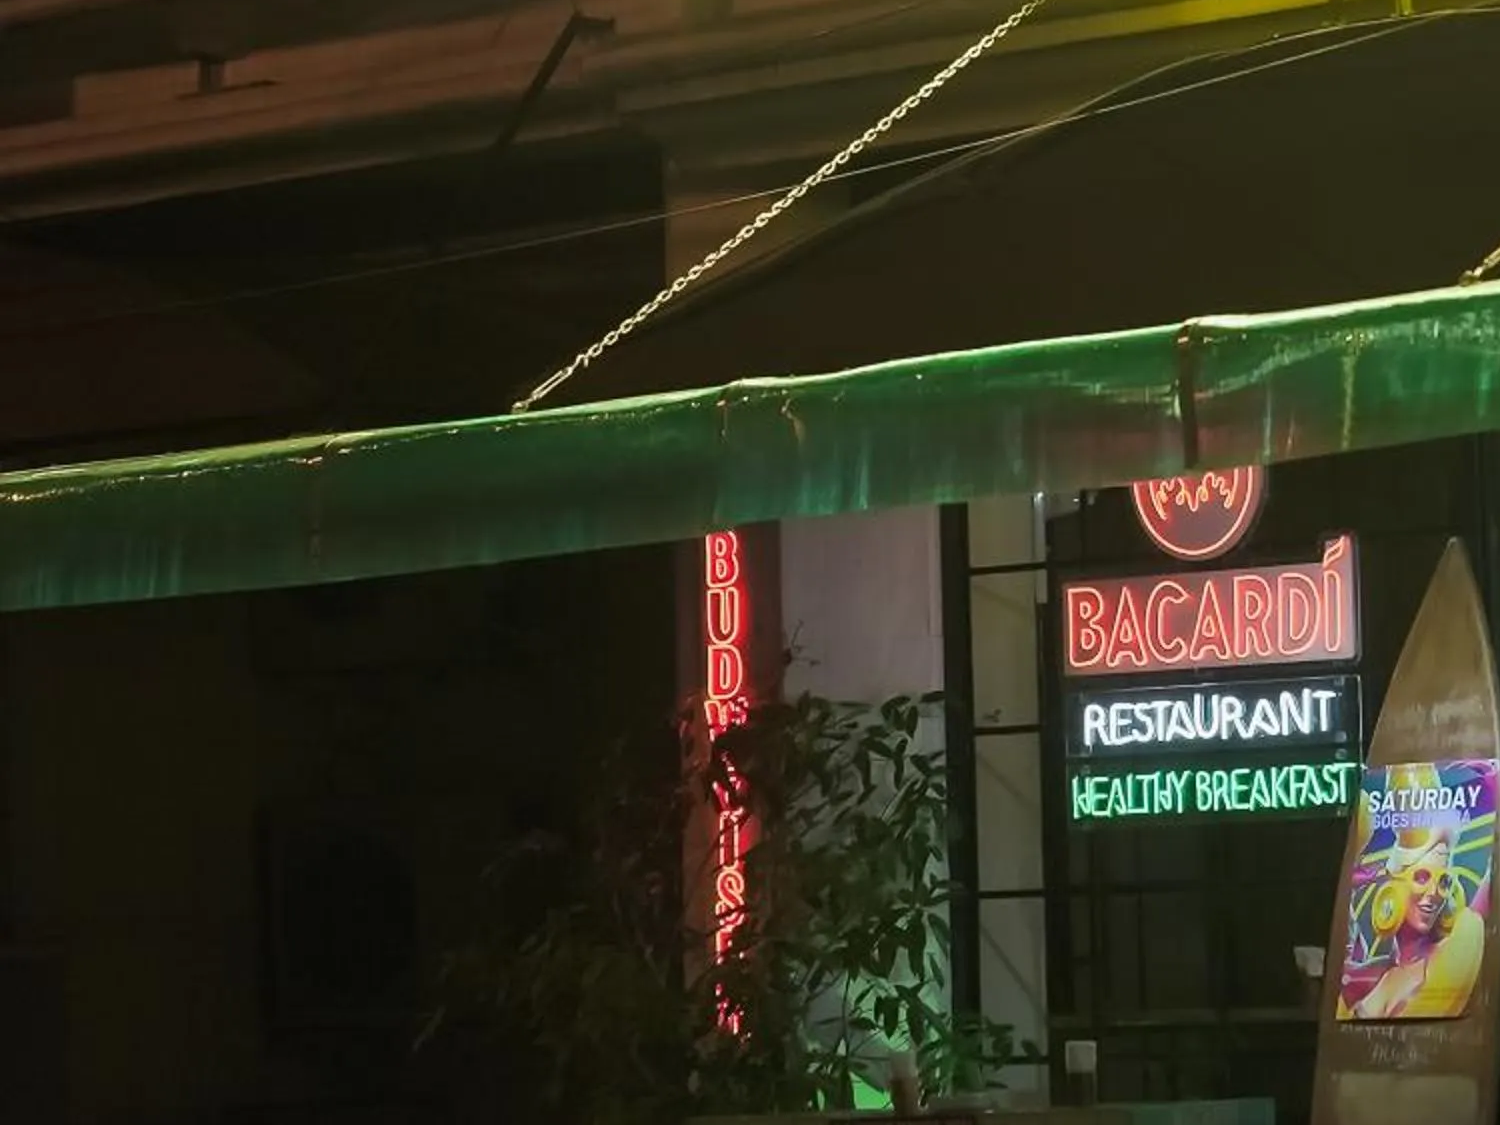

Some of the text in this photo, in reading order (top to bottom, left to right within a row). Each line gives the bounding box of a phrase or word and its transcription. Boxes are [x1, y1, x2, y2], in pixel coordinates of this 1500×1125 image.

[1066, 535, 1345, 668] BACARDÍ
[1083, 688, 1338, 747] RESTAURANT
[1072, 762, 1358, 819] HEALTHY BREAKFAST
[1368, 785, 1481, 813] SATURDAY
[1374, 811, 1409, 829] GOES
